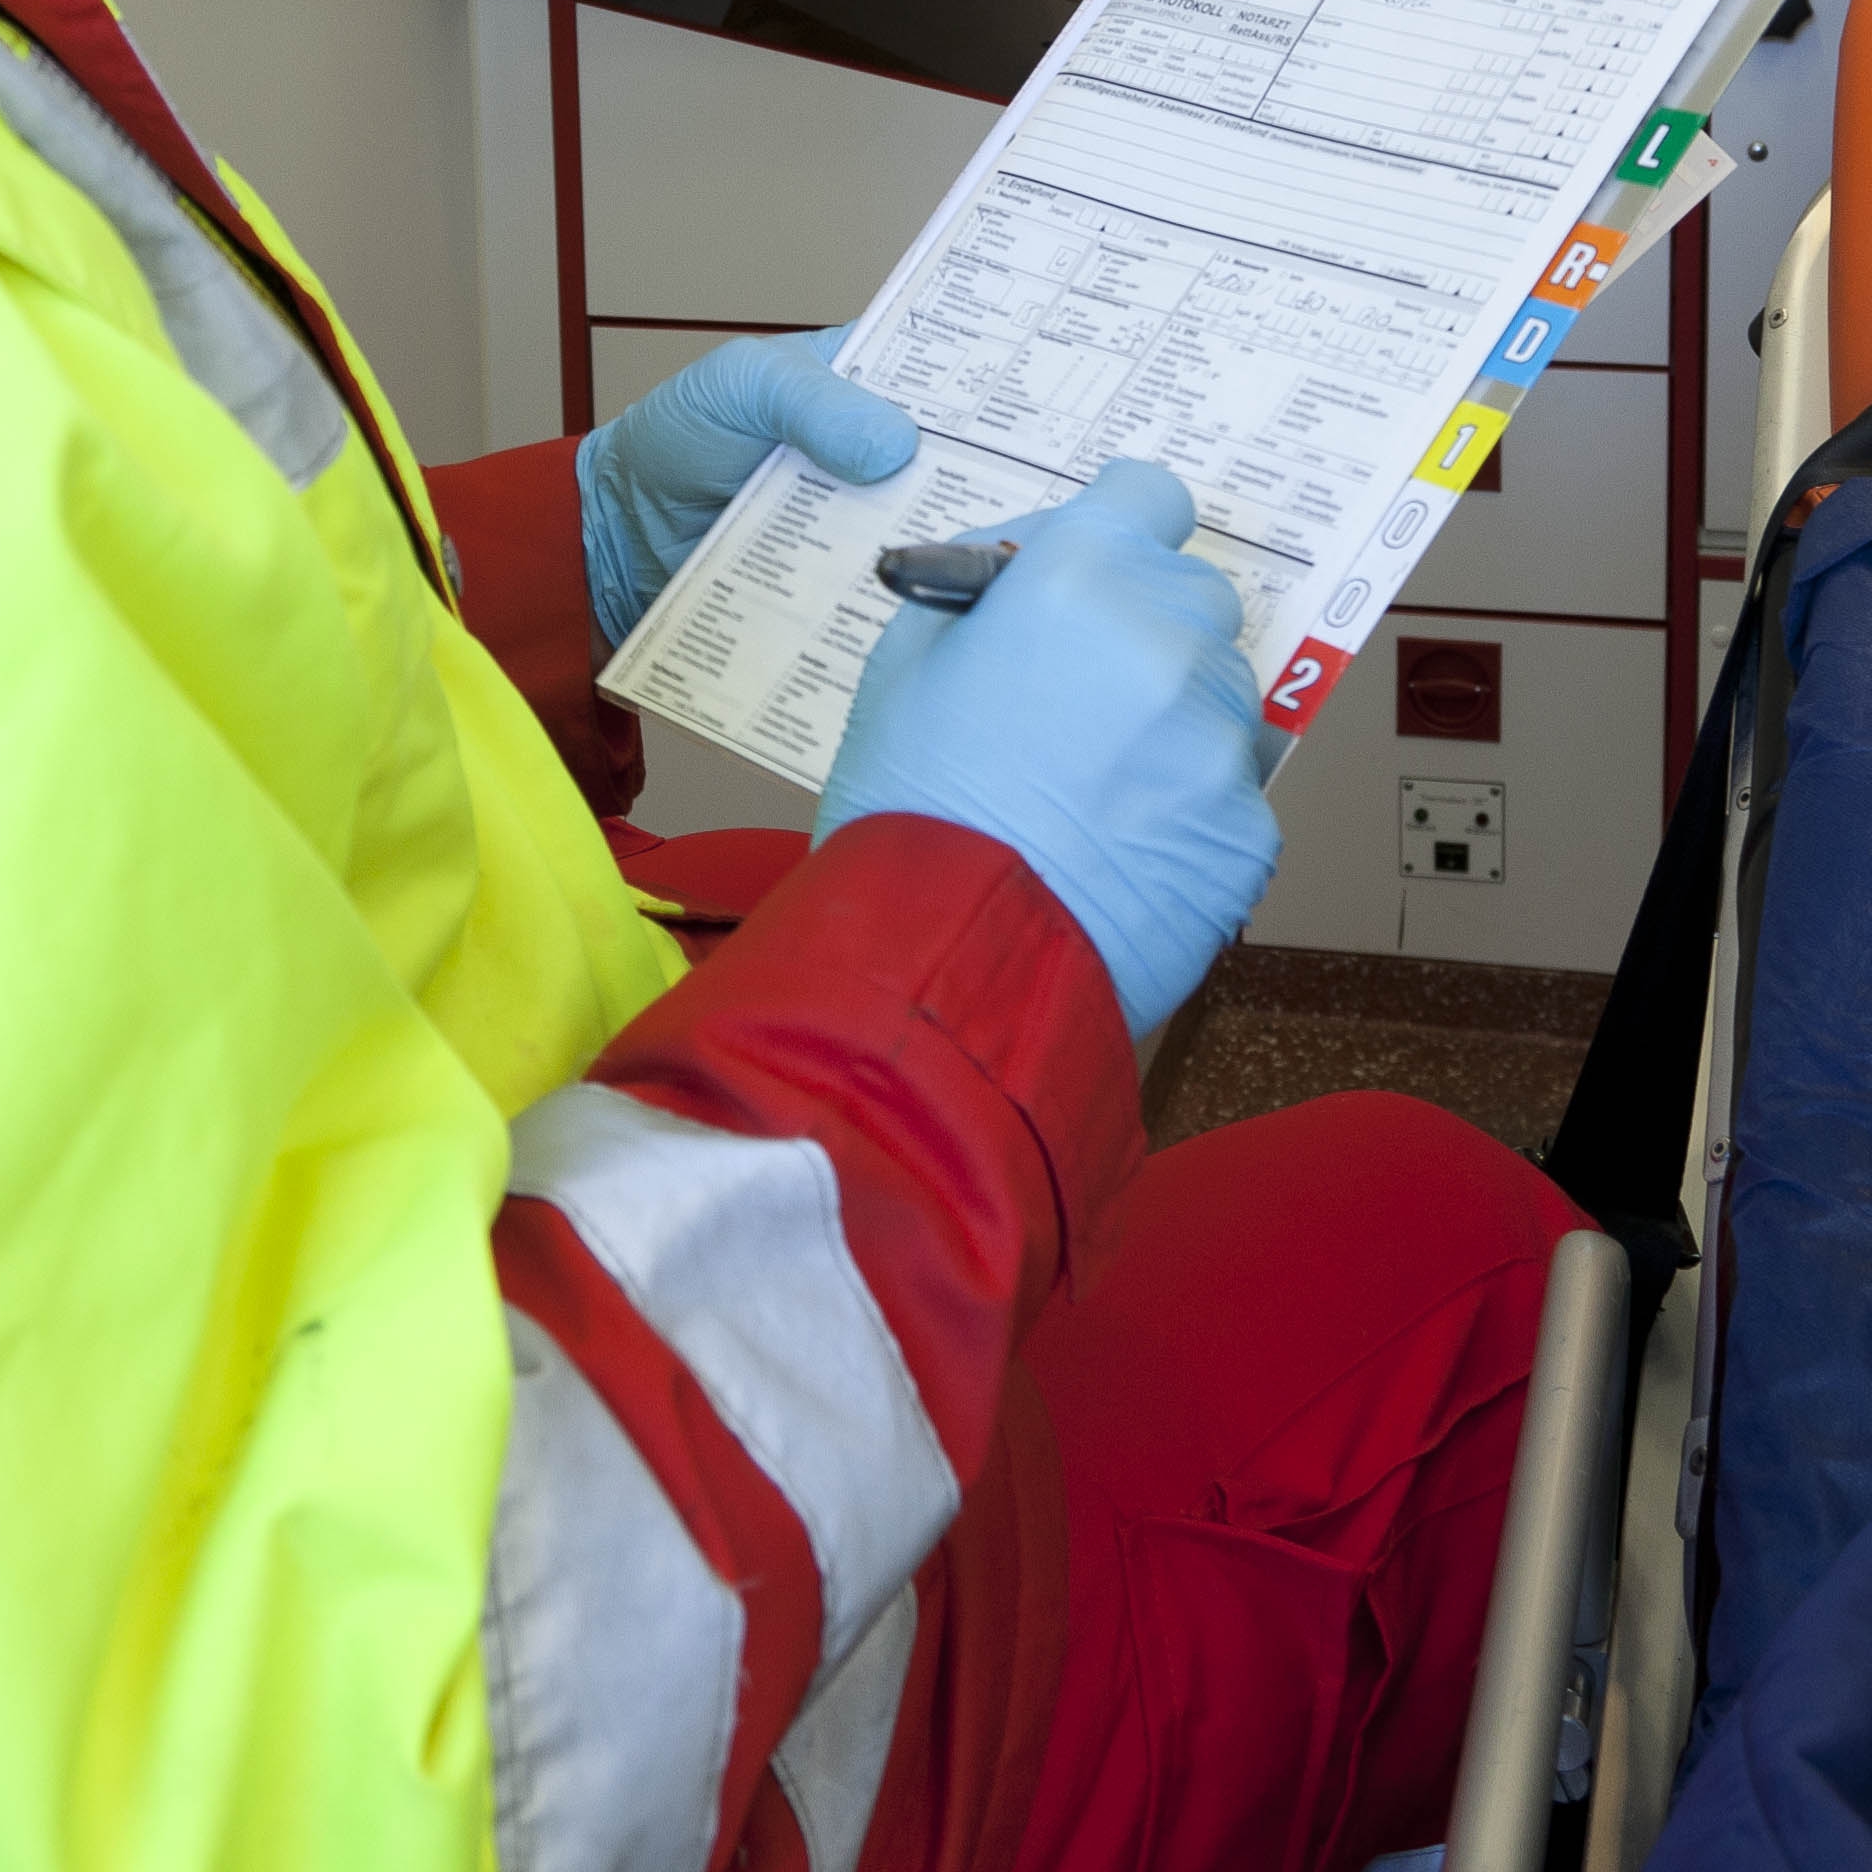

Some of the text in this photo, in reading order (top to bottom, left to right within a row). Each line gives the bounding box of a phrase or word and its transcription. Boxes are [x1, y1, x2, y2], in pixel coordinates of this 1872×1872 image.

[1228, 23, 1294, 47] RettAss/RS
[1238, 9, 1292, 30] NOTARZT
[1075, 79, 1148, 106] Notfallgeschehen
[1157, 101, 1205, 120] Anamnese
[1214, 116, 1269, 138] Erstbefund
[1637, 123, 1671, 170] L
[1504, 316, 1550, 364] D
[1440, 424, 1478, 470] 1
[1272, 658, 1322, 711] 2
